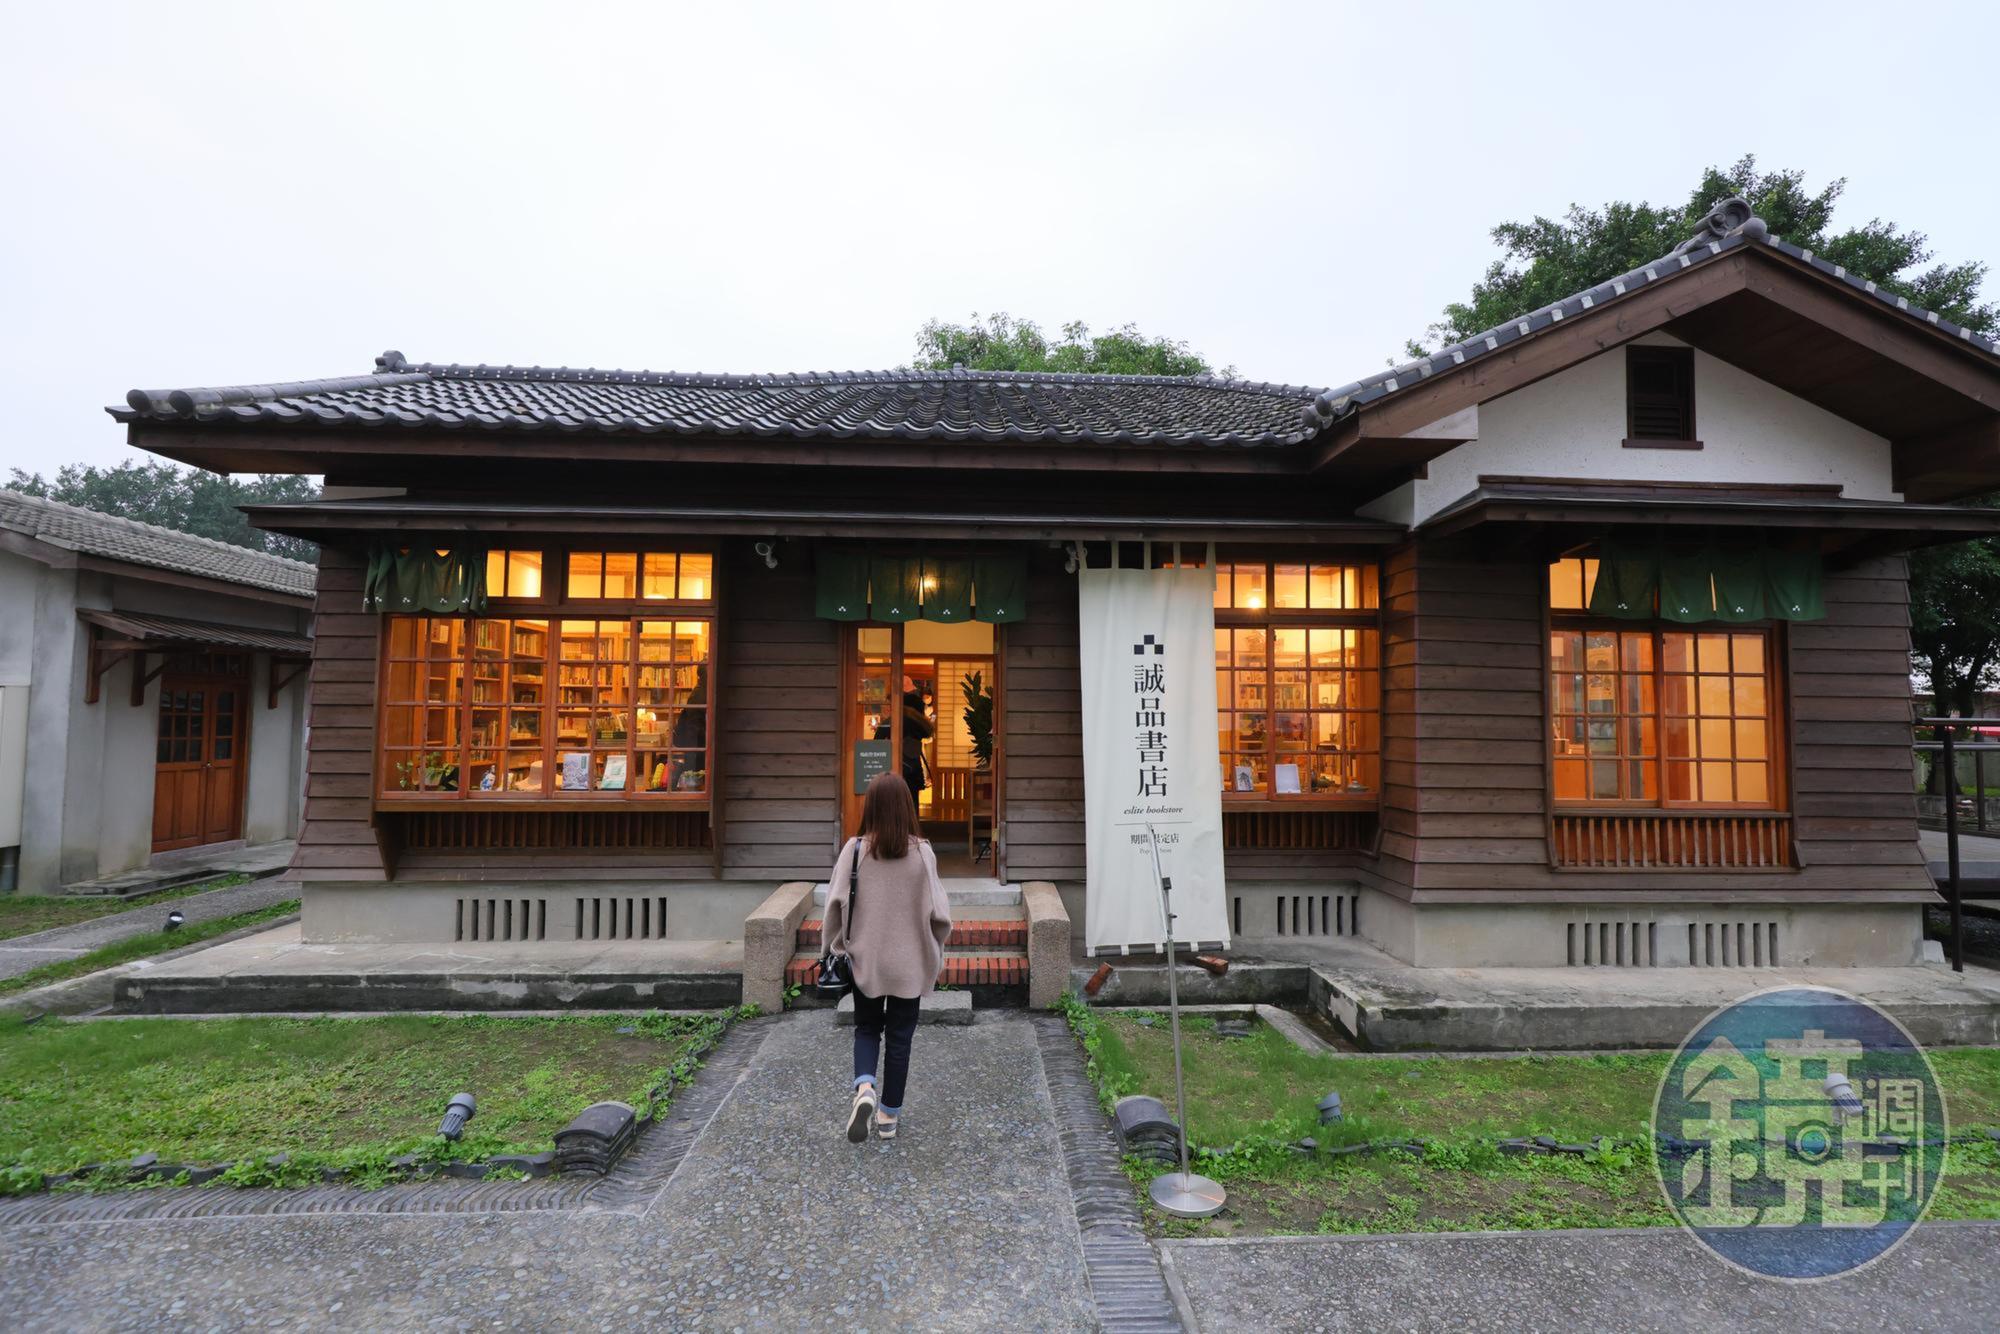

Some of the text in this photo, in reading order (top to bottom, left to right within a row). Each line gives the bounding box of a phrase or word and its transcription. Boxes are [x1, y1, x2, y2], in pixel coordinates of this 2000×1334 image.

[1134, 663, 1168, 797] 誠品書店
[1123, 805, 1184, 815] eslite bookstore
